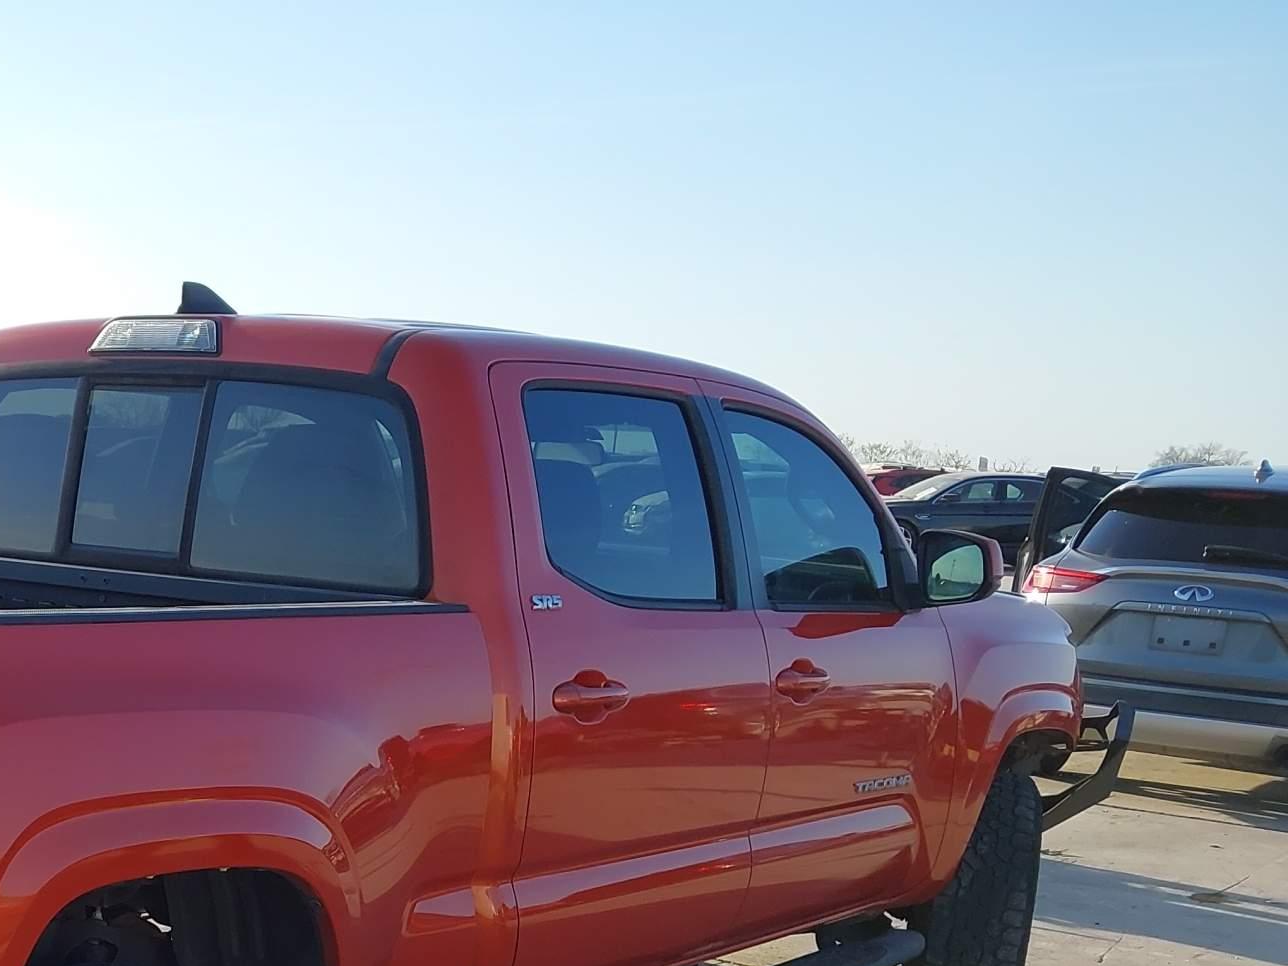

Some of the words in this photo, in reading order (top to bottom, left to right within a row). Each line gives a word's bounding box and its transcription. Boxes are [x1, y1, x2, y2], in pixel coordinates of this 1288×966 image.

[532, 594, 563, 610] SR5
[1147, 604, 1234, 616] INFINITI
[856, 775, 913, 791] TACOMA
